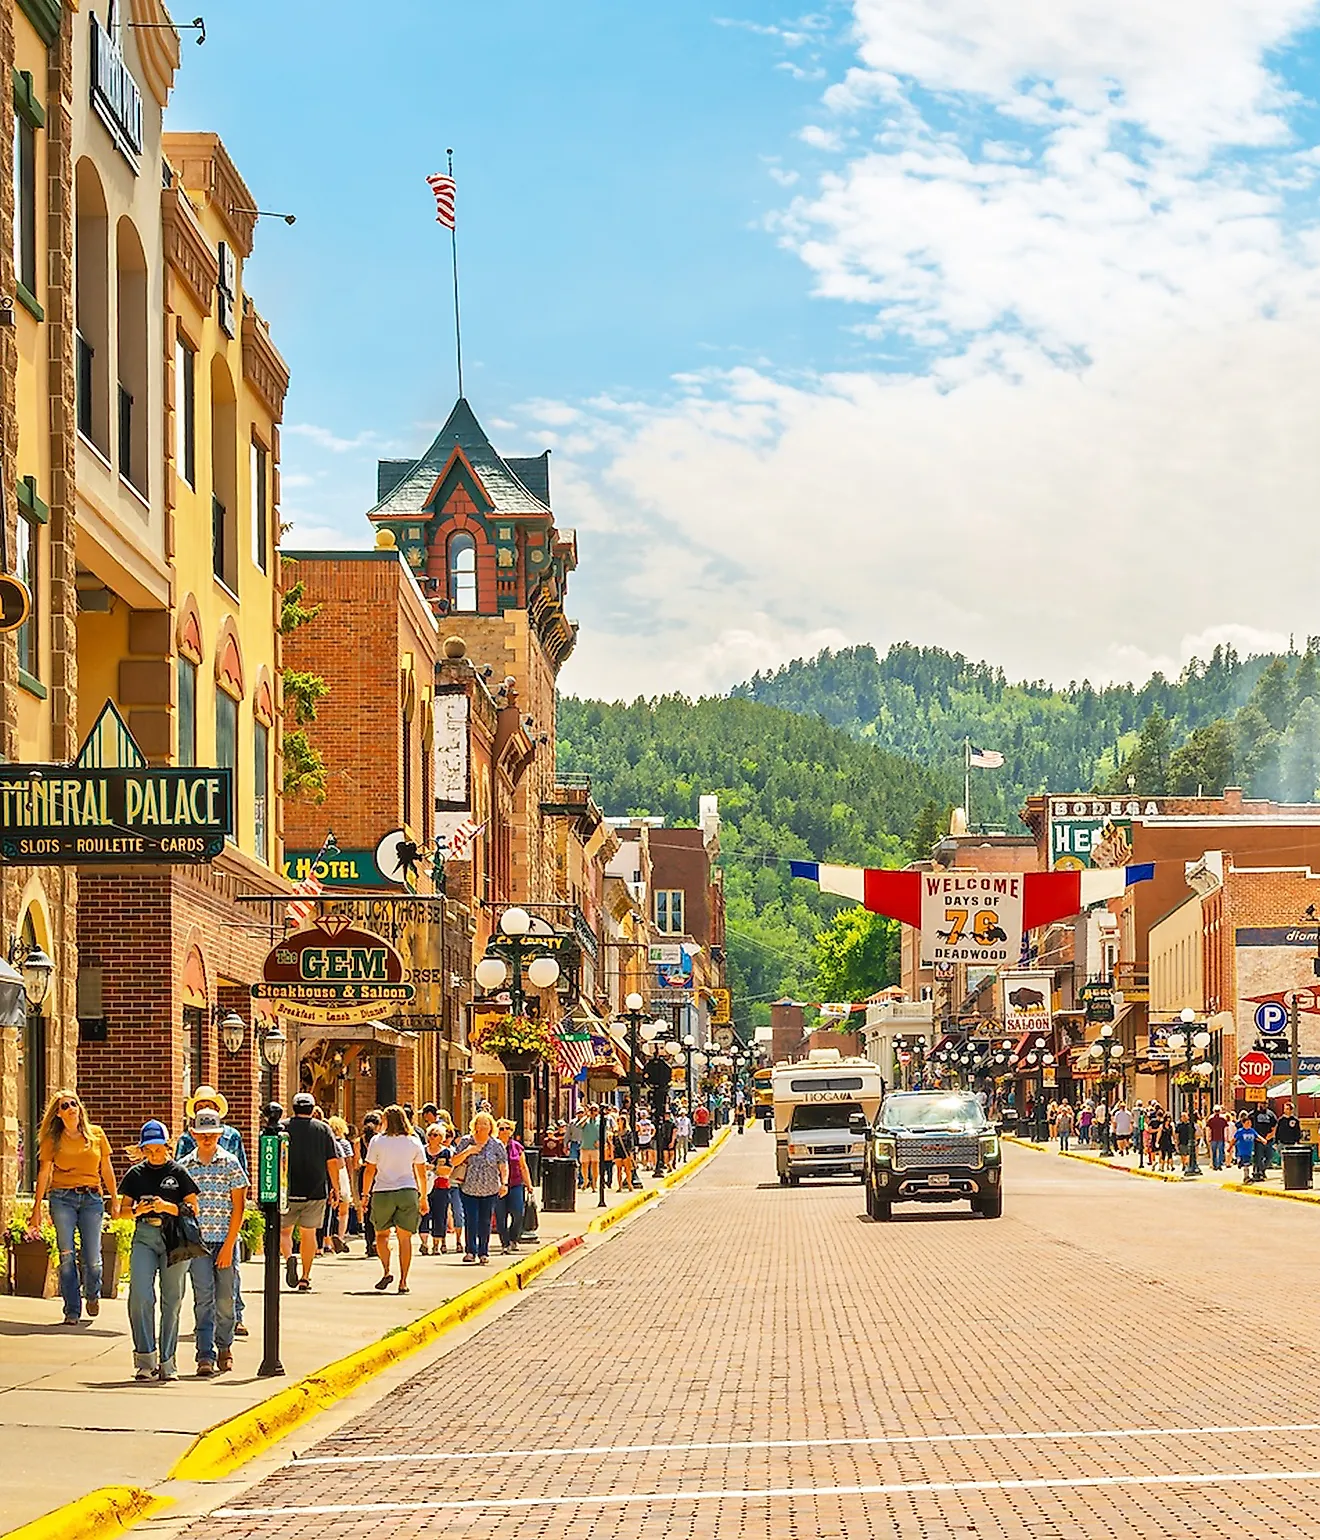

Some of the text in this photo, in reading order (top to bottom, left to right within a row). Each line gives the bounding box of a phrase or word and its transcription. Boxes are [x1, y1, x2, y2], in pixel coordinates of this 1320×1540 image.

[0, 778, 220, 827] MINERAL PALACE
[1054, 800, 1160, 817] BODEGA
[20, 839, 60, 853] SLOTS
[77, 838, 144, 853] ROULETTE
[160, 837, 205, 852] CARDS
[296, 857, 360, 879] HOTEL
[926, 877, 1019, 899] WELCOME
[944, 896, 1000, 906] DAYS OF
[944, 908, 1000, 947] 76
[935, 948, 1007, 960] DEADWOOD
[277, 947, 388, 981] The GEM
[404, 968, 441, 984] ORSE
[257, 984, 407, 999] Steakhouse & Saloon
[1007, 1018, 1050, 1030] SALOON
[1264, 1008, 1282, 1030] P
[1239, 1062, 1271, 1076] STOP
[265, 1138, 273, 1191] TROLLEY
[261, 1191, 278, 1200] STOP
